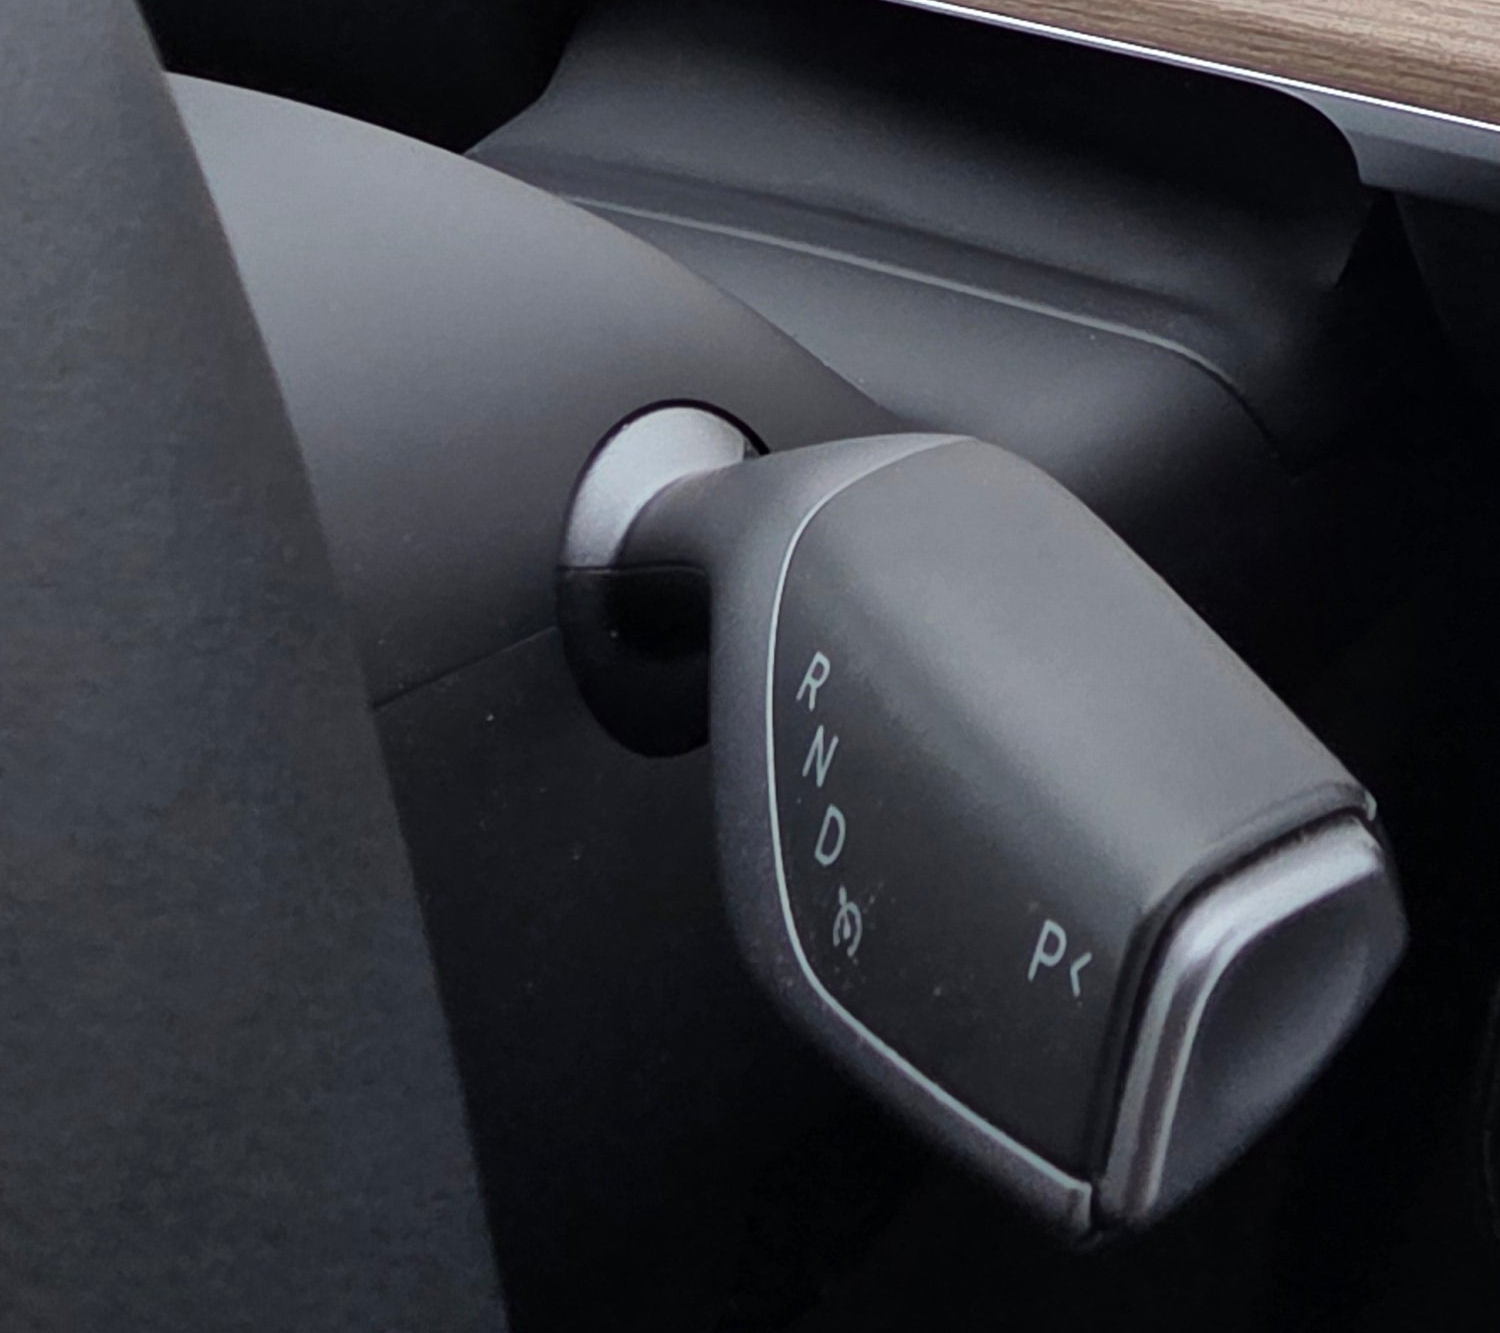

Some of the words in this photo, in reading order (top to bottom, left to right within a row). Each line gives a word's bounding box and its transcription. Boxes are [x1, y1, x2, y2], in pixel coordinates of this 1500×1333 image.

[796, 651, 831, 711] R
[803, 725, 839, 788] N
[814, 803, 846, 866] D
